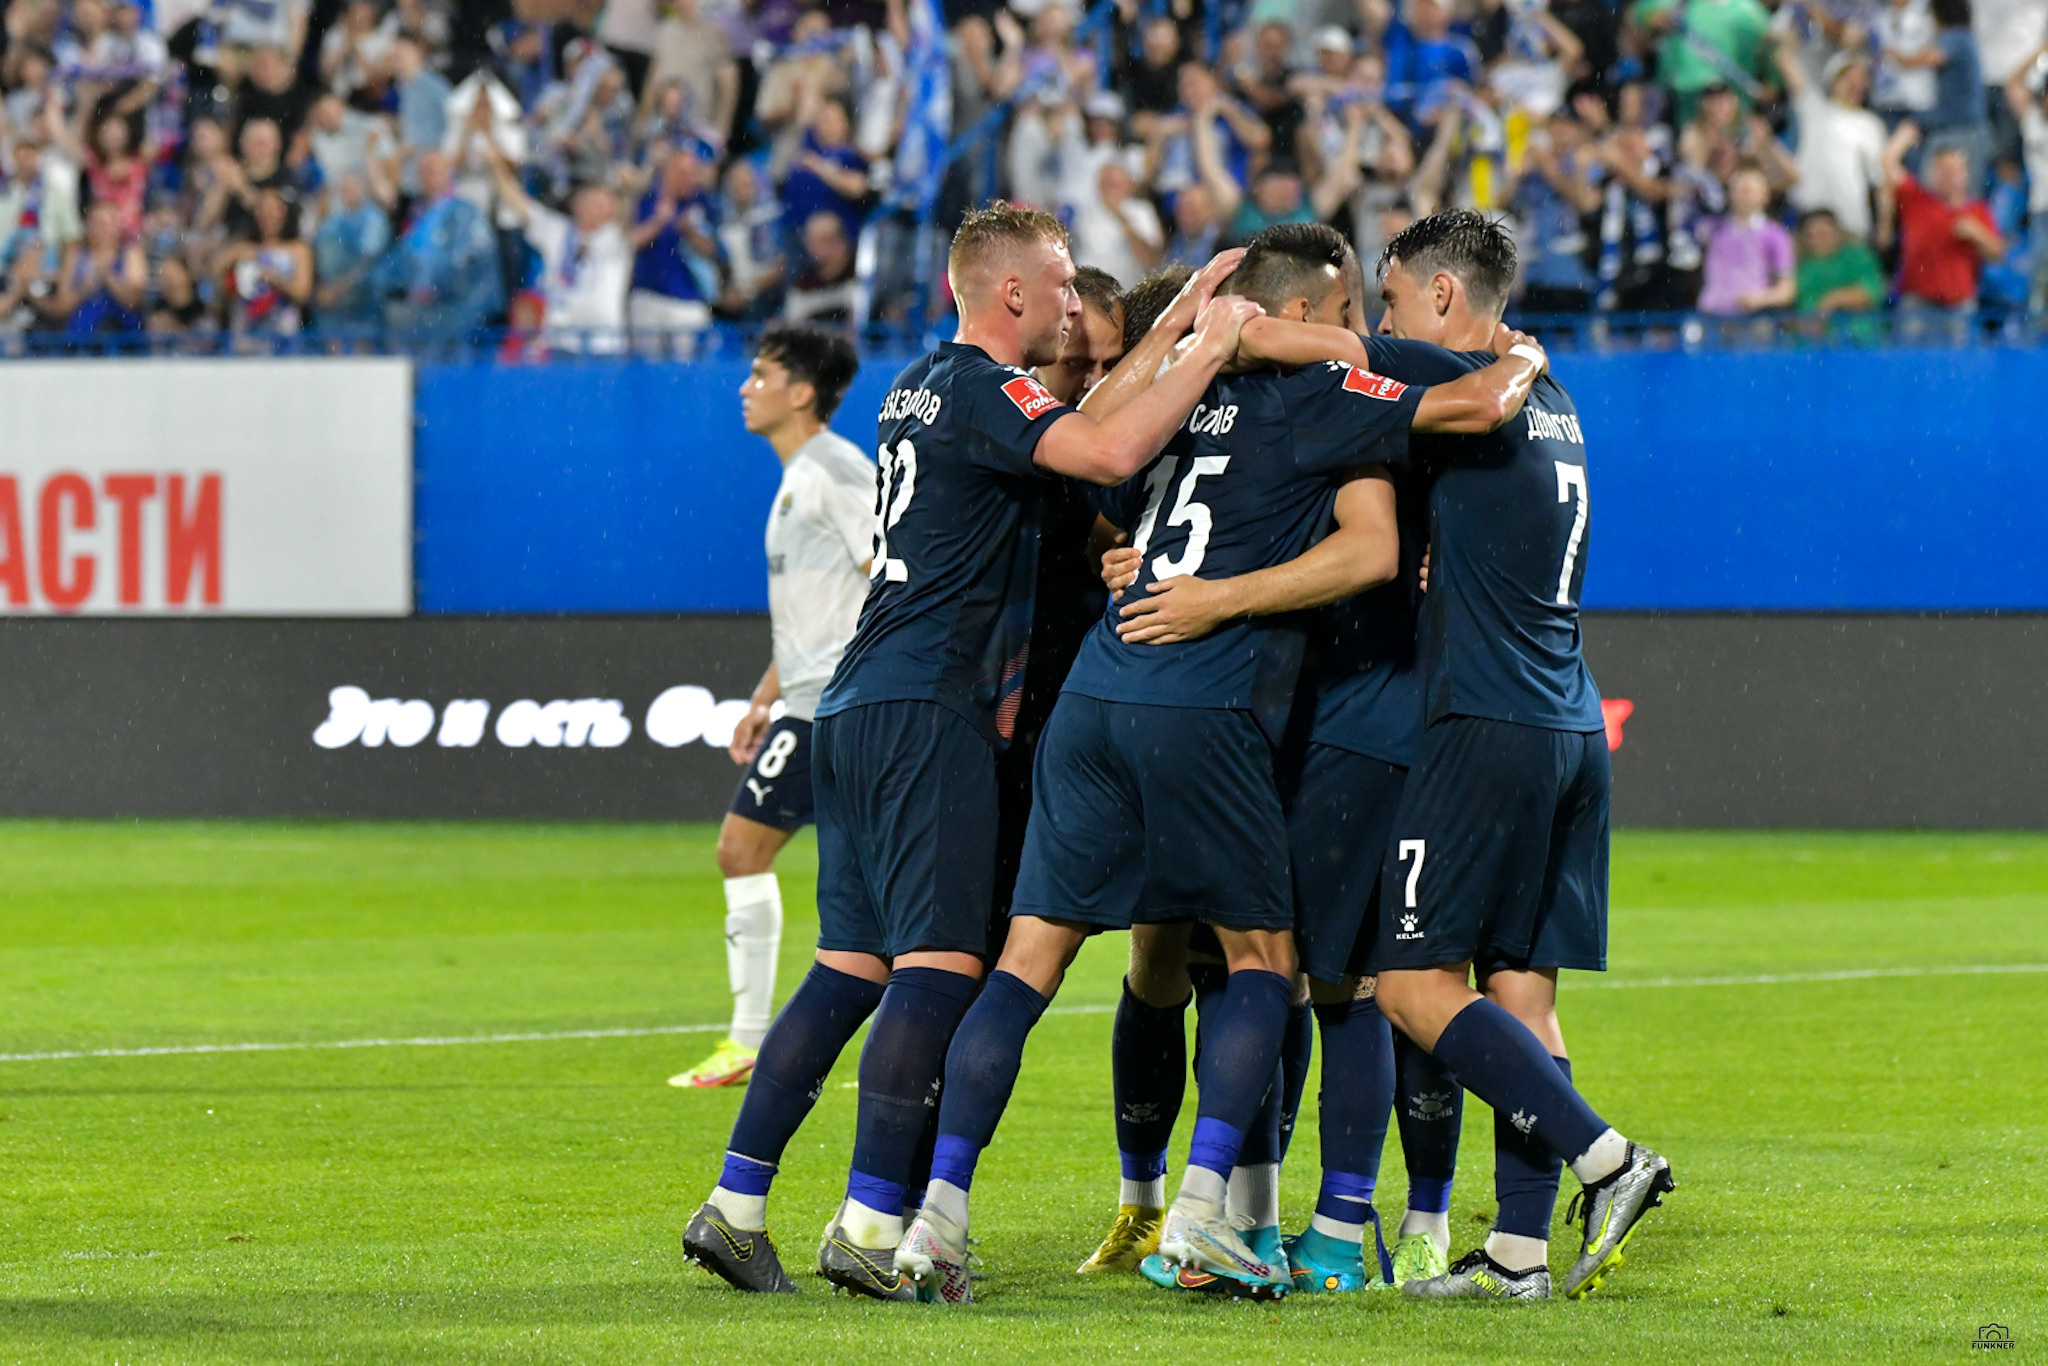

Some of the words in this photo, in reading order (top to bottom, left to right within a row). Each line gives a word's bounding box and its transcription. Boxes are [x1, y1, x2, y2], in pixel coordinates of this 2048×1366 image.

[1127, 454, 1232, 586] 15
[1555, 460, 1588, 605] 7
[757, 729, 798, 779] 8
[1398, 839, 1426, 908] 7
[1396, 931, 1425, 940] KELME
